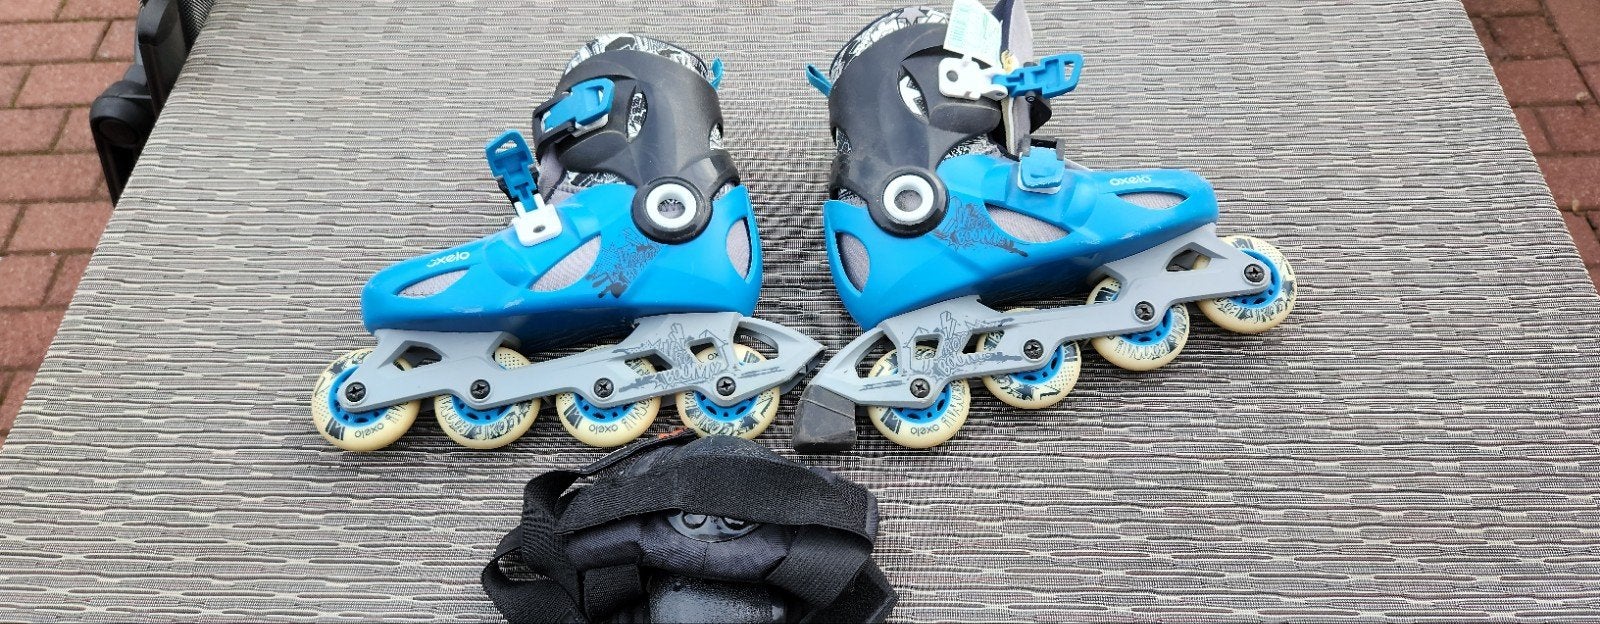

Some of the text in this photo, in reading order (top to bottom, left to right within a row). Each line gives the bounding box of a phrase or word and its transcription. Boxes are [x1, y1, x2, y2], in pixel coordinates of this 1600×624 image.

[1109, 175, 1152, 186] oxelo
[354, 422, 384, 439] oxelo
[588, 422, 619, 434] oxelo
[910, 422, 940, 437] oxelo
